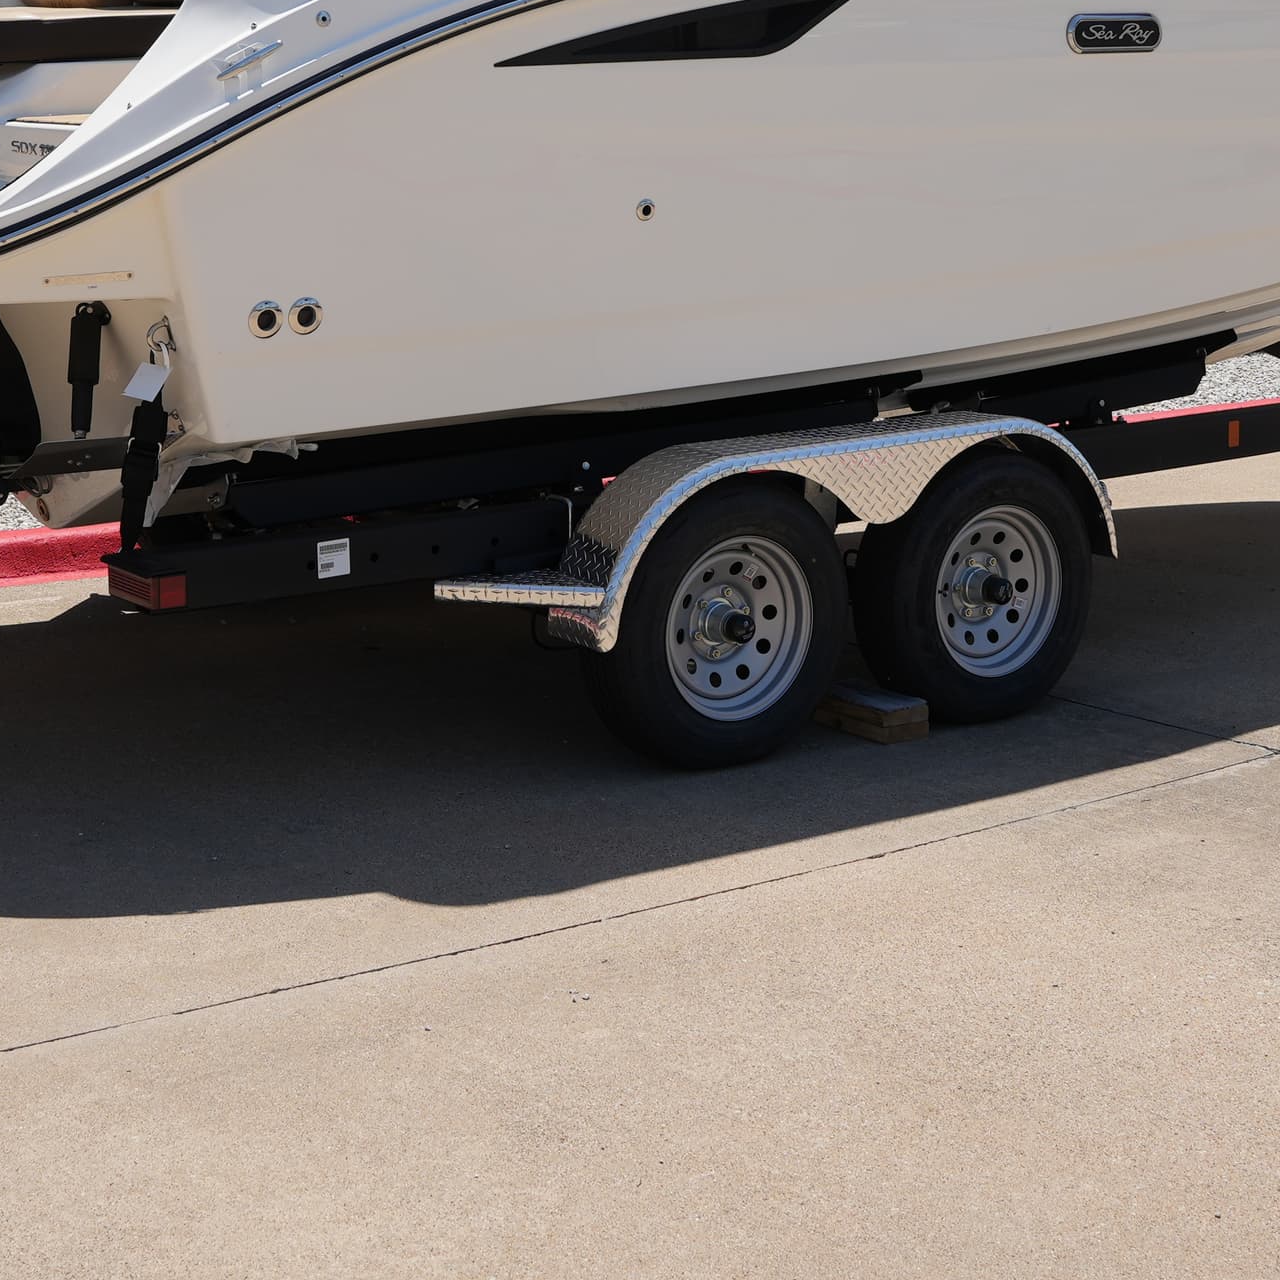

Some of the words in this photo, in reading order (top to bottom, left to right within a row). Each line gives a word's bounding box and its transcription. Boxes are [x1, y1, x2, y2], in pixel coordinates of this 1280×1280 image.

[1082, 24, 1117, 40] Sea
[1119, 22, 1155, 44] Ray
[11, 140, 38, 156] SDX
